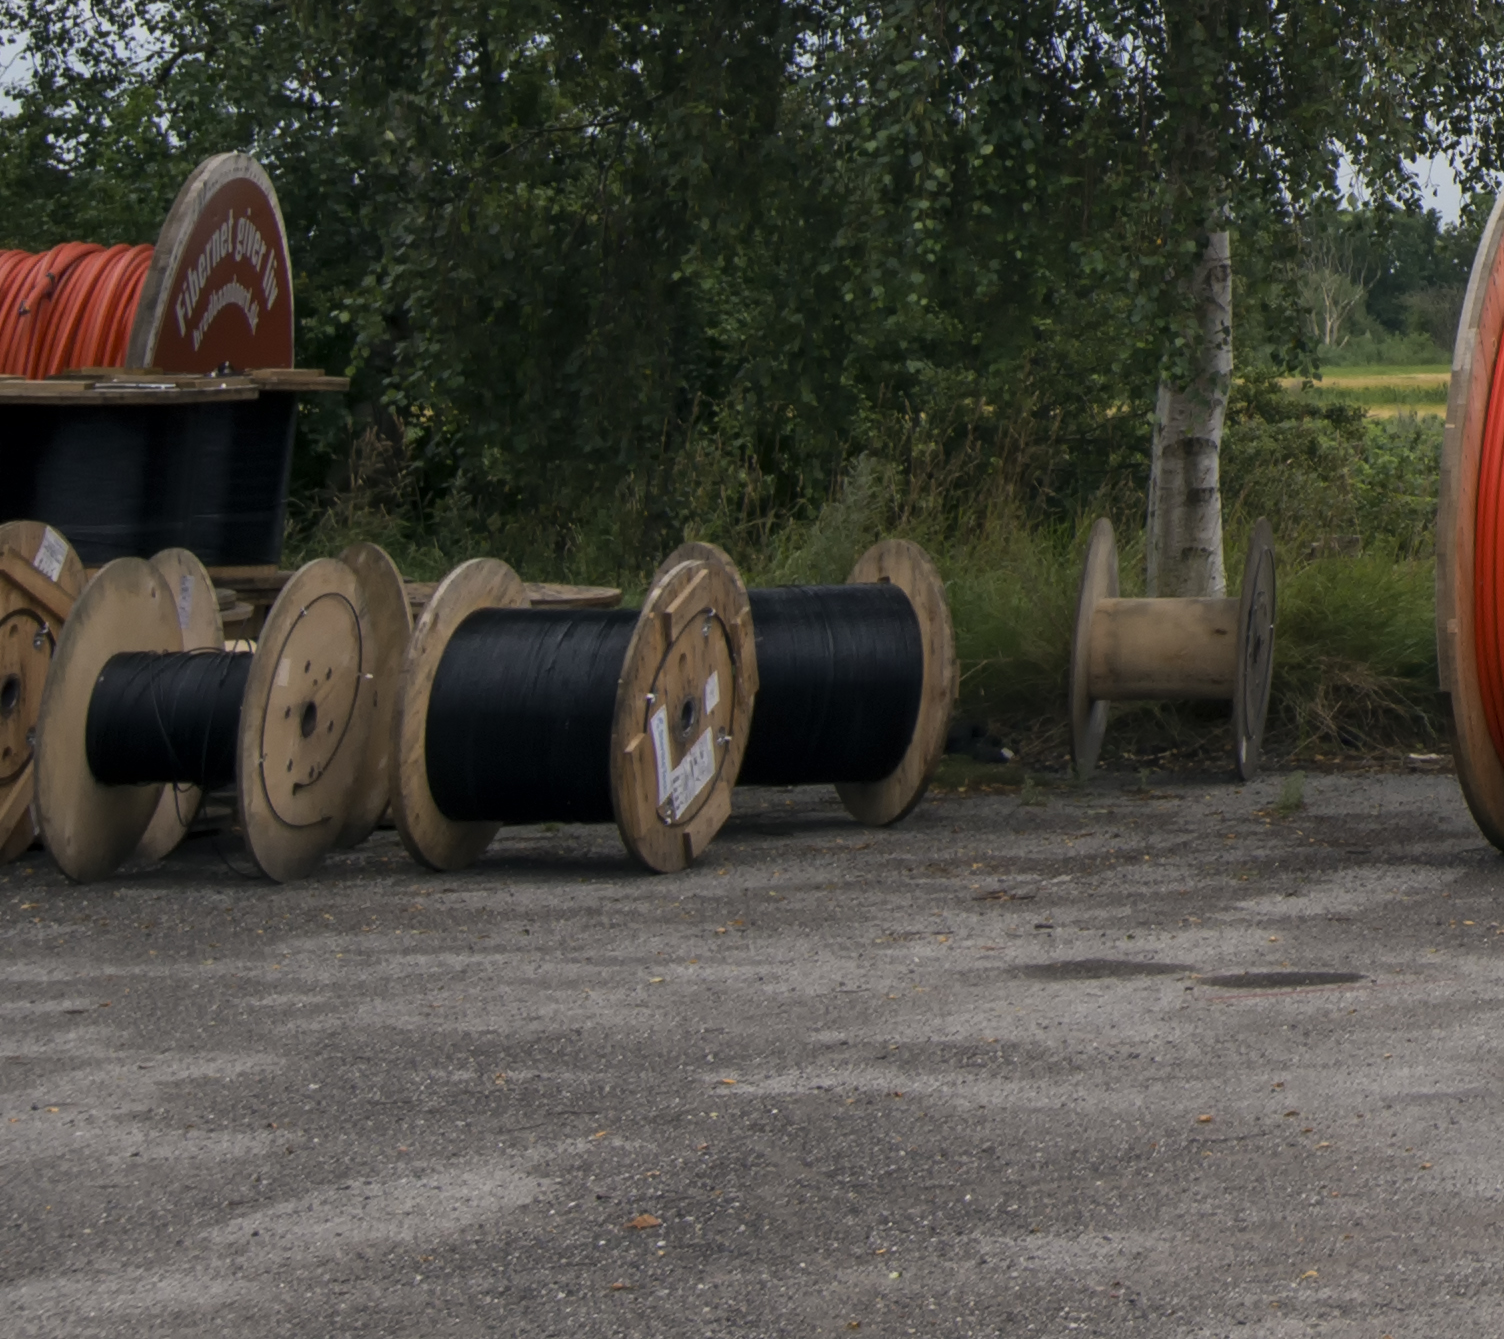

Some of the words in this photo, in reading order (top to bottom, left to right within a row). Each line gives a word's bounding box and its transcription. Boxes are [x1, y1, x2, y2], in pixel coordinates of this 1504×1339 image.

[175, 208, 234, 338] Fibernet
[234, 207, 267, 273] giver
[262, 247, 278, 311] liv
